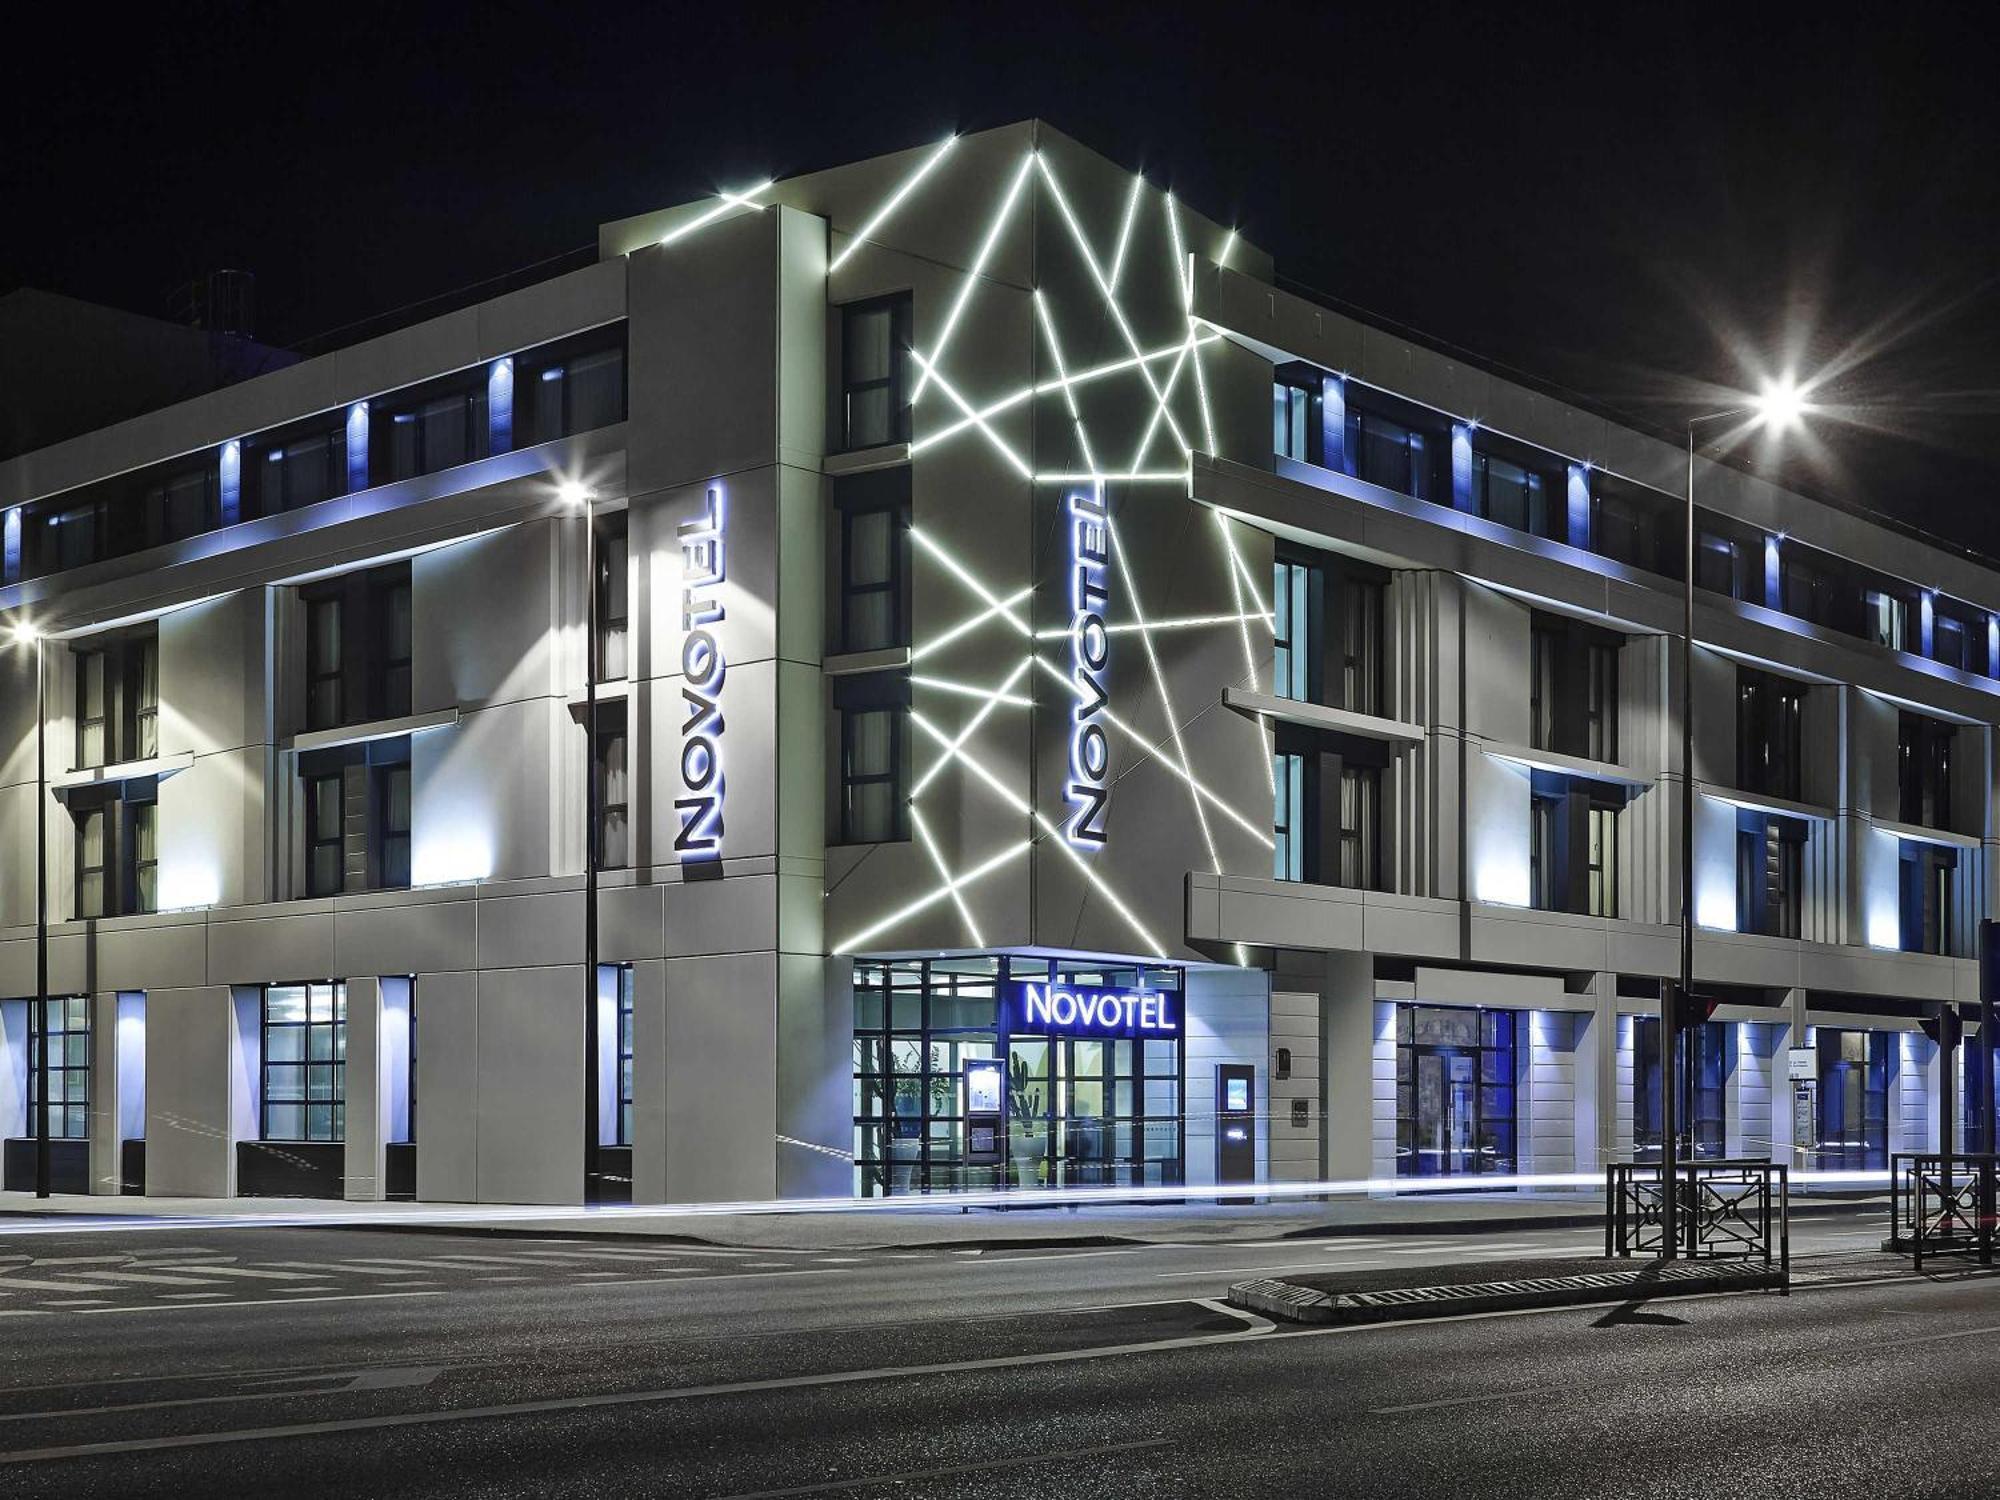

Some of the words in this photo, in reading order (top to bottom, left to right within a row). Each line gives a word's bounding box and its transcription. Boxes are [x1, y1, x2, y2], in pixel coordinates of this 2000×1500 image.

[674, 485, 722, 853] NOVOTEL
[1068, 475, 1109, 845] NOVOTEL
[1025, 983, 1177, 1030] NOVOTEL
